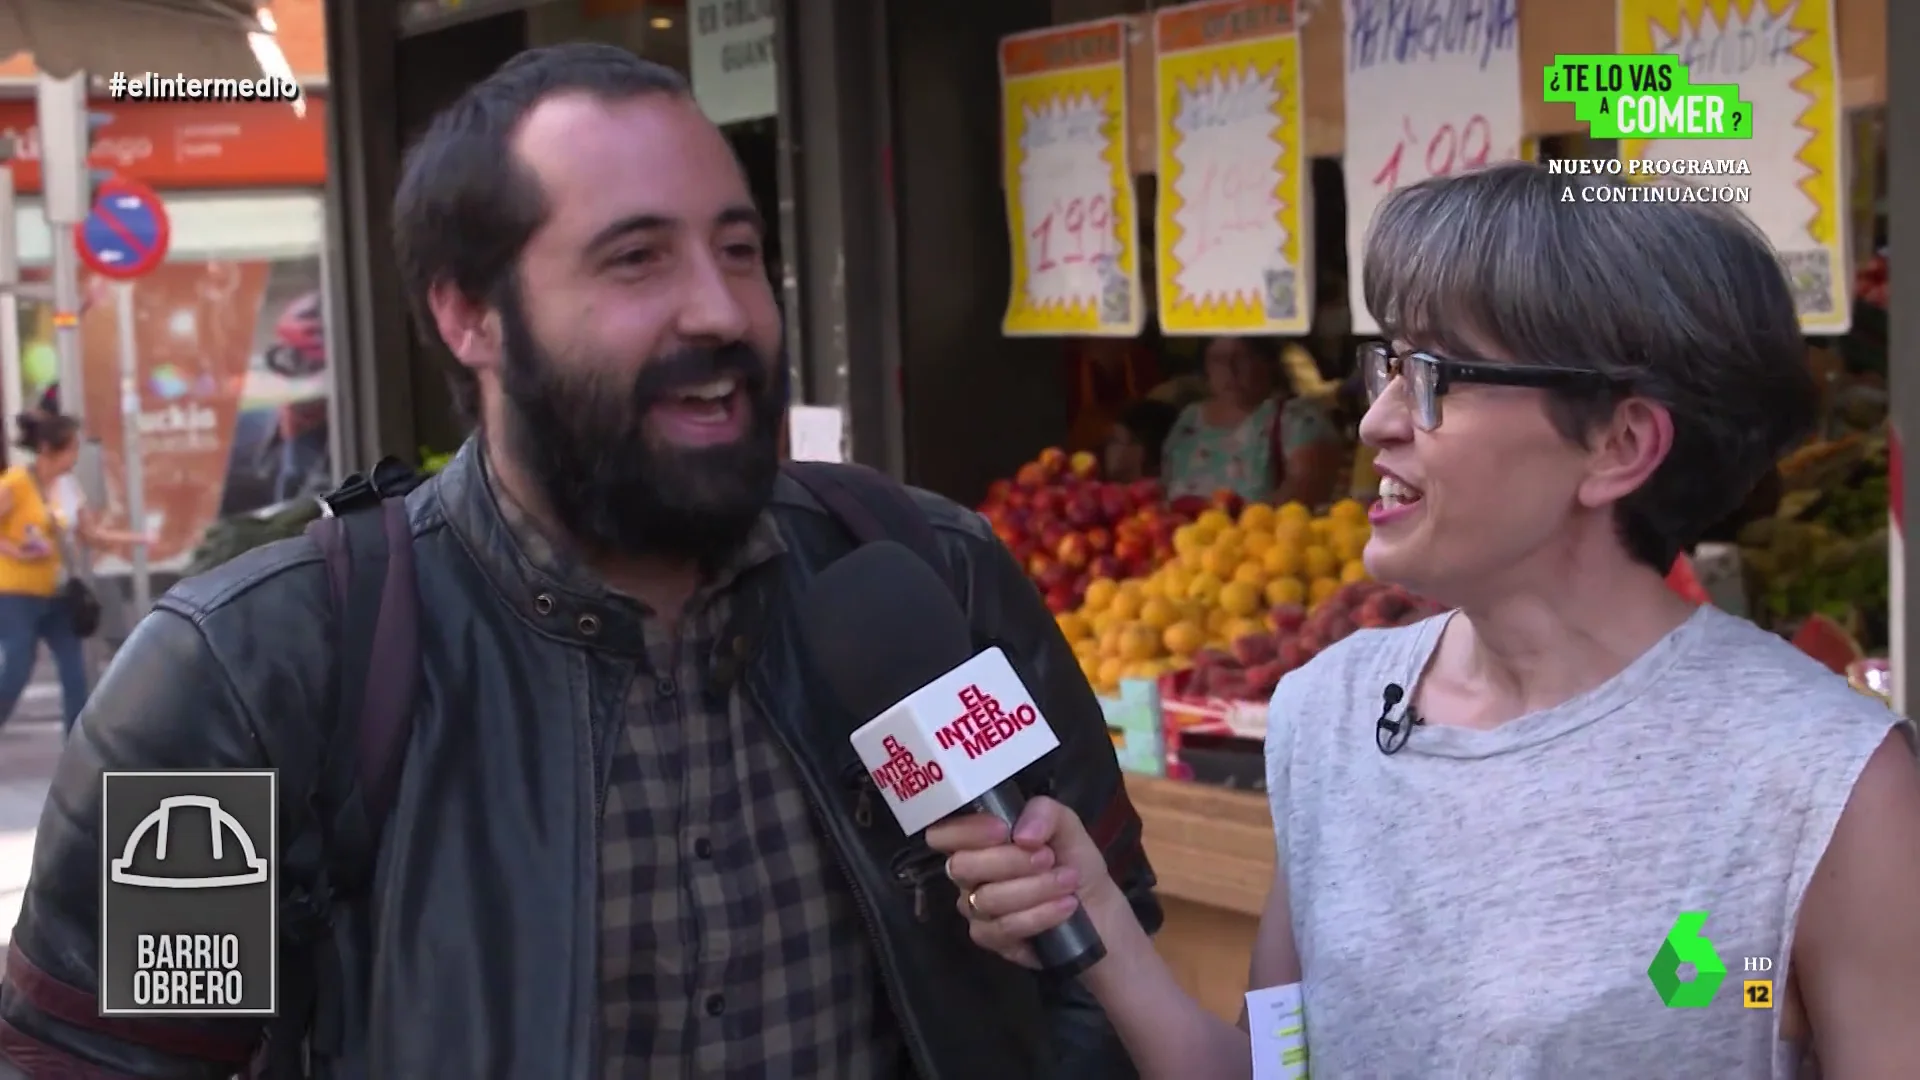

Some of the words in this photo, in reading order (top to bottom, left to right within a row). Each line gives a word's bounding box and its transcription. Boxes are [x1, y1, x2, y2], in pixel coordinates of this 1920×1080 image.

[958, 684, 990, 709] EL
[935, 699, 1005, 749] INTER
[962, 703, 1036, 759] MEDIO
[882, 734, 905, 757] EL
[872, 751, 918, 789] INTER
[892, 760, 944, 801] MEDIO
